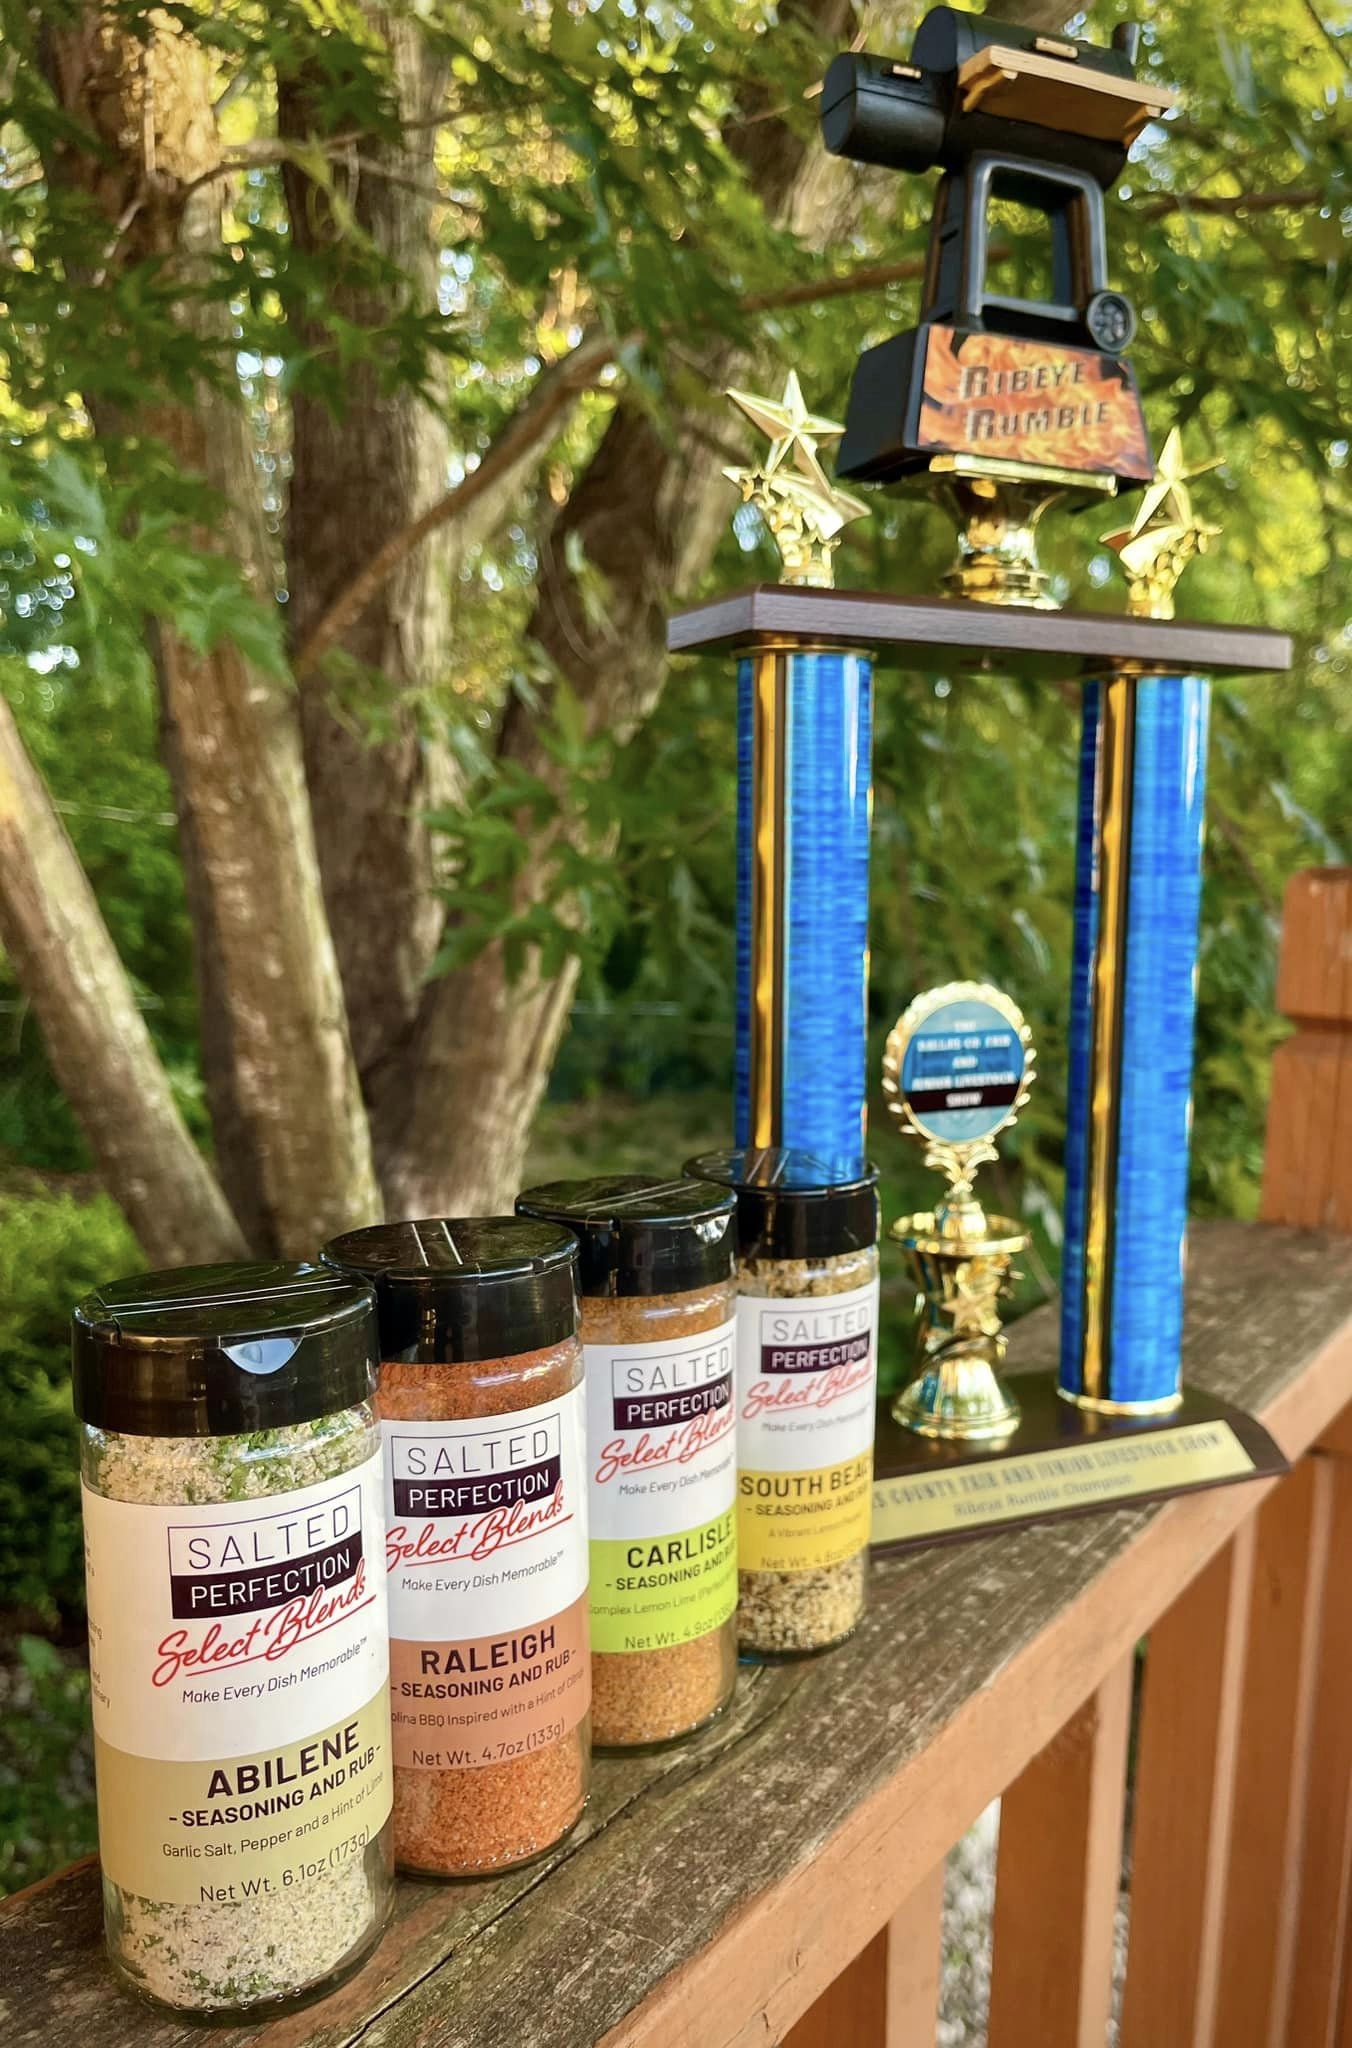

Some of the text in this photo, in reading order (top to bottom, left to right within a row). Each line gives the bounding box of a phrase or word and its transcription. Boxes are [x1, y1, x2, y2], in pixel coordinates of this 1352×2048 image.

[960, 360, 1087, 398] RIBEYE
[967, 401, 1110, 442] RUMBLE
[772, 1306, 869, 1342] SALTED
[626, 1346, 730, 1393] SALTED
[771, 1338, 868, 1369] PERFECTION
[627, 1380, 731, 1424] PERFECTION
[742, 1378, 816, 1420] Select
[407, 1430, 549, 1475] SALTED
[595, 1429, 678, 1484] Select
[889, 1479, 956, 1505] COUNTY
[959, 1471, 999, 1492] FAIR
[1002, 1463, 1034, 1485] AND
[1095, 1438, 1177, 1468] LIVESTOCK
[1178, 1430, 1220, 1452] SHOW
[409, 1468, 549, 1509] PERFECTION
[619, 1484, 647, 1496] Make
[650, 1480, 682, 1494] Every
[740, 1474, 823, 1497] SOUTH
[756, 1499, 833, 1516] SEASONING
[188, 1505, 349, 1570] SALTED
[386, 1478, 565, 1573] Select Blends
[627, 1514, 732, 1568] CARLISLE
[191, 1548, 351, 1609] PERFECTION
[402, 1578, 433, 1591] Make
[435, 1576, 471, 1593] Every
[473, 1572, 499, 1588] Dish
[616, 1564, 701, 1590] SEASONING
[703, 1554, 723, 1574] AND
[761, 1556, 785, 1569] Net
[152, 1557, 367, 1688] Select Blends
[634, 1600, 672, 1615] Lemon
[673, 1594, 696, 1608] Lime
[421, 1625, 556, 1676] RALEIGH
[625, 1636, 652, 1649] Net
[655, 1631, 681, 1646] Wt.
[182, 1688, 221, 1704] Make
[223, 1683, 266, 1701] Every
[267, 1667, 298, 1692] Dish
[401, 1677, 504, 1699] SEASONING
[508, 1665, 543, 1689] AND
[546, 1650, 570, 1675] RUB
[419, 1714, 446, 1728] BBQ
[447, 1709, 499, 1727] Inspired
[500, 1703, 527, 1719] with
[527, 1700, 535, 1710] a
[536, 1688, 556, 1705] Hint
[557, 1680, 566, 1696] of
[207, 1721, 360, 1799] ABILENE
[412, 1716, 565, 1766] Net Wt. 4.7oz (133g)
[182, 1789, 304, 1828] SEASONING
[309, 1768, 346, 1801] AND
[349, 1746, 376, 1779] RUB
[162, 1843, 202, 1859] Garlic
[204, 1843, 237, 1858] Salt,
[240, 1828, 294, 1855] Pepper
[295, 1814, 320, 1838] and
[321, 1814, 330, 1826] a
[331, 1797, 354, 1821] Hint
[355, 1785, 365, 1804] of
[200, 1824, 371, 1903] Net Wt. 6.1oz (173g)
